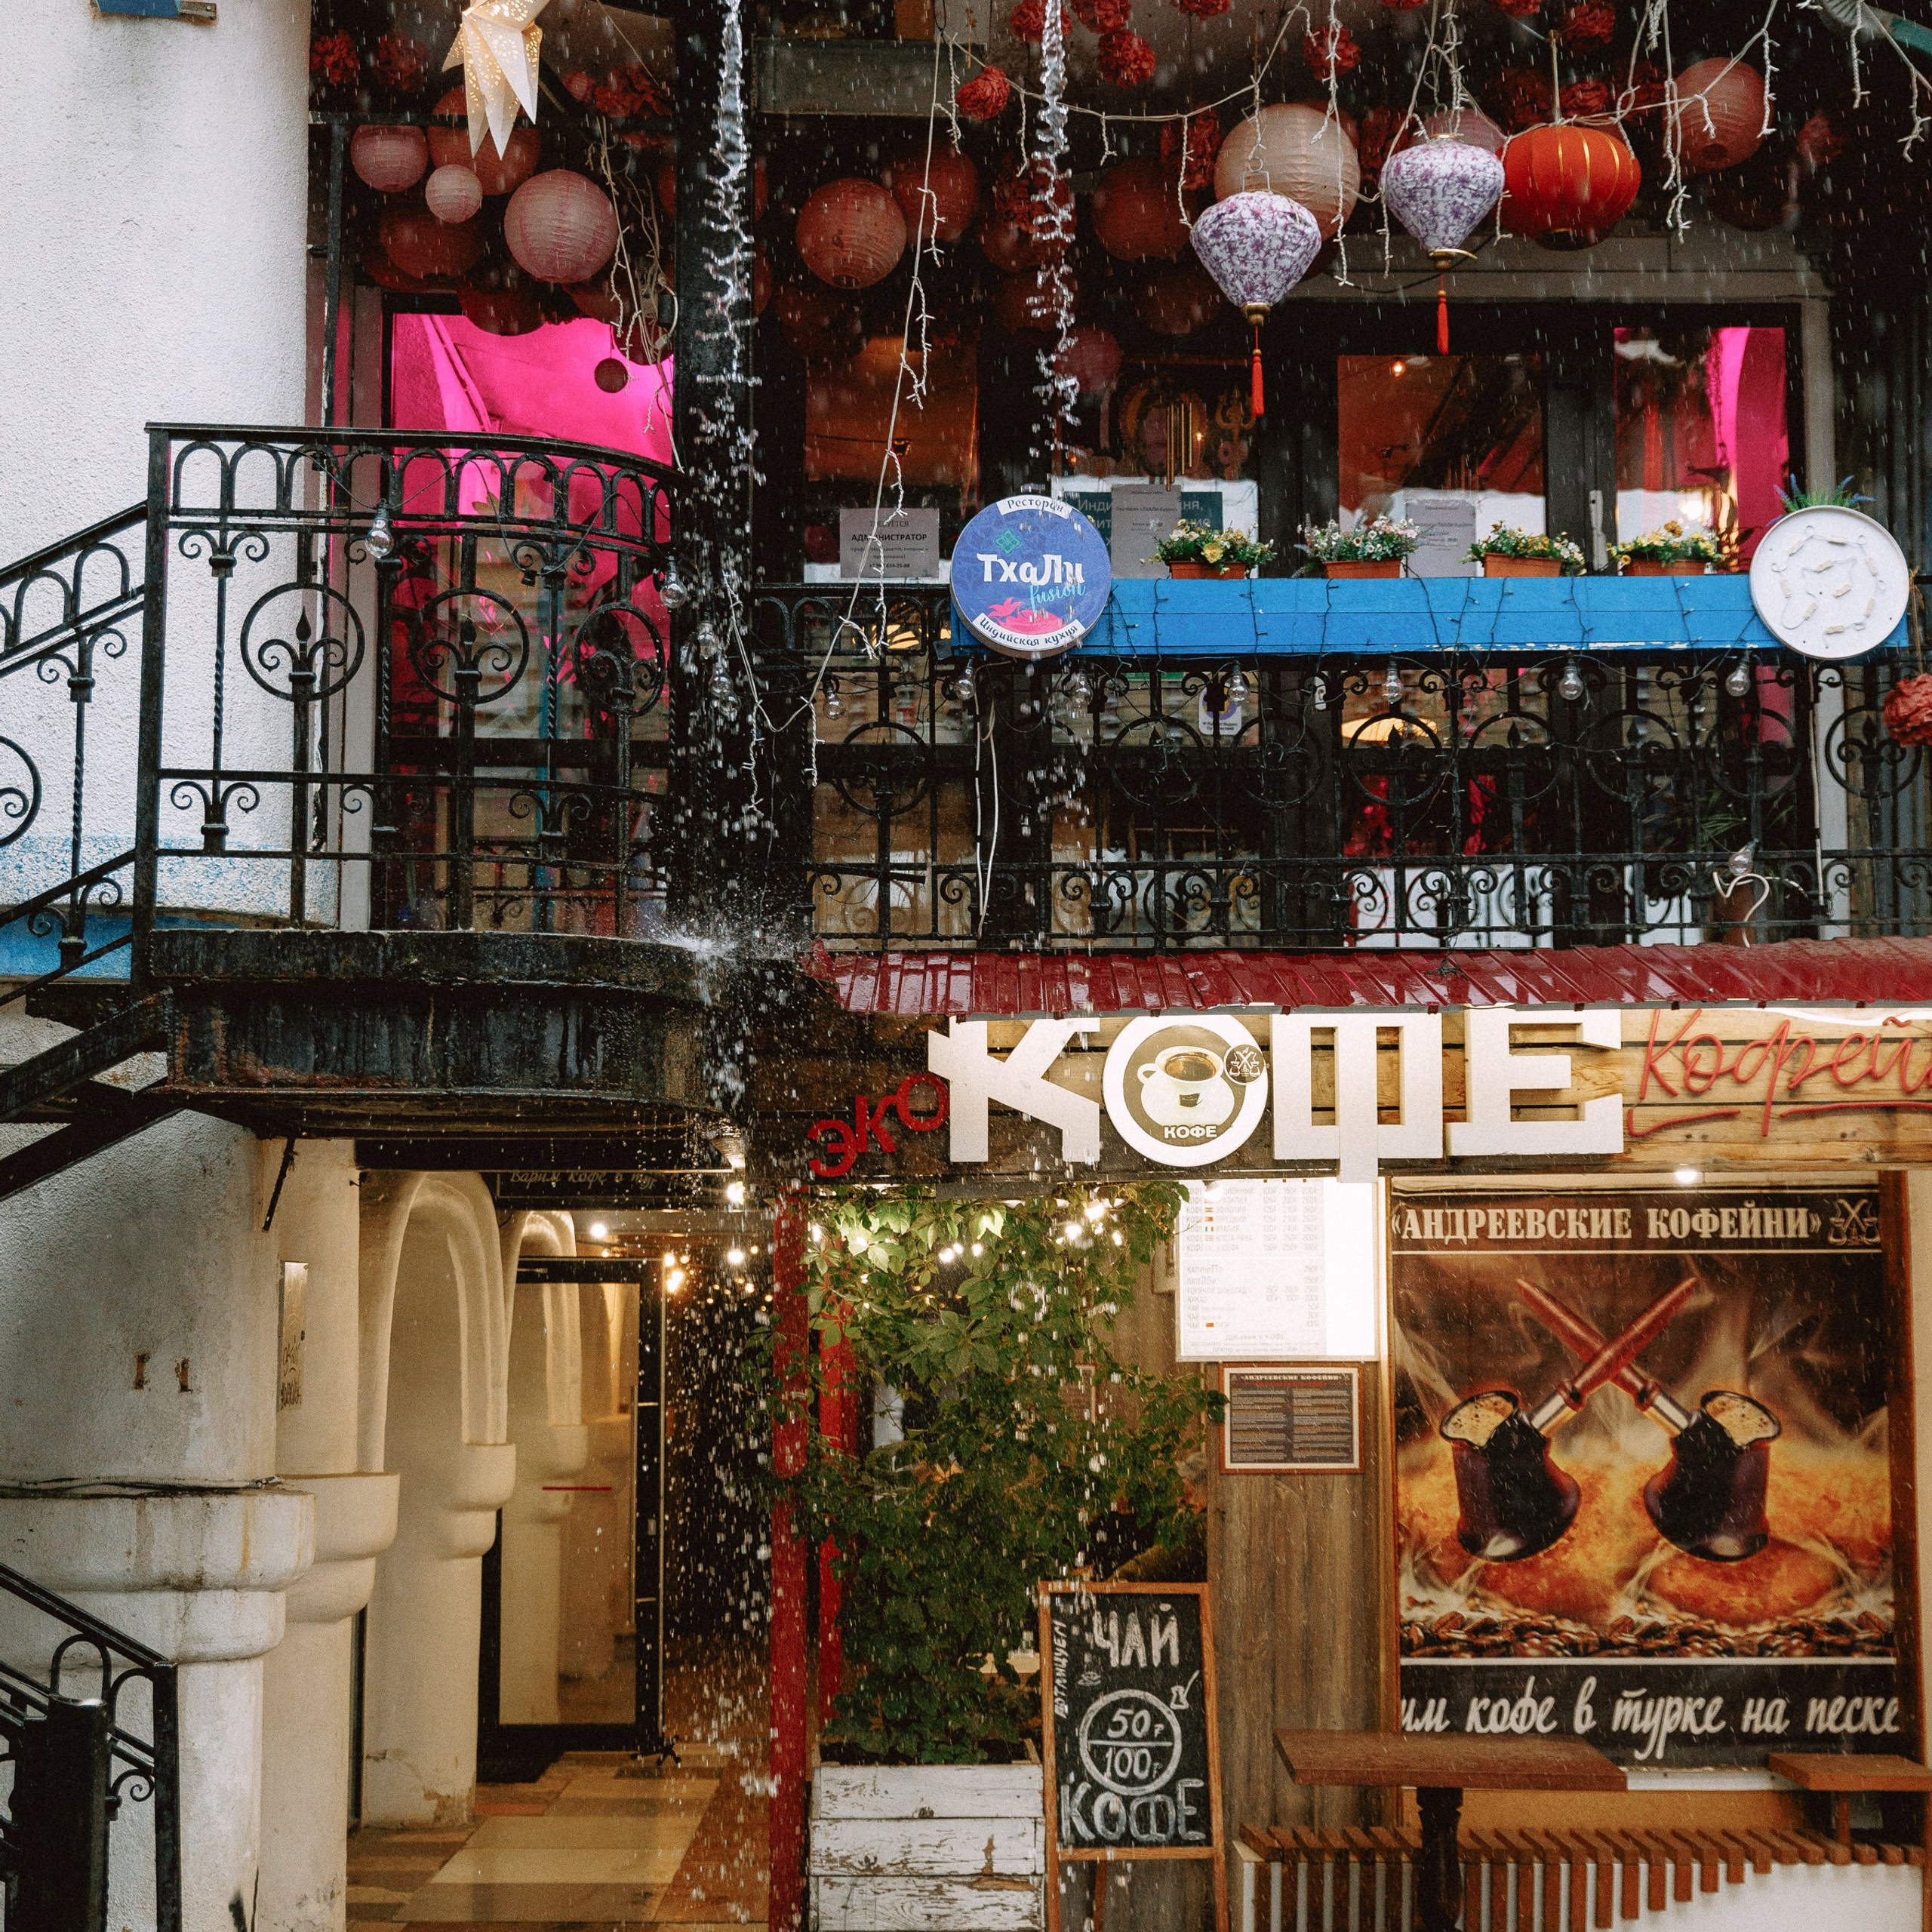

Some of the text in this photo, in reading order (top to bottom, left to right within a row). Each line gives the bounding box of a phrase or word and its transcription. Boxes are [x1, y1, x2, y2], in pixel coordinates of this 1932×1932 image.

[1007, 499, 1064, 513] Ресторан
[1029, 583, 1086, 614] fusion
[980, 617, 1078, 647] Индийская кухня
[1163, 1125, 1217, 1139] КОФЕ
[1391, 1200, 1822, 1245] «АНДРЕЕВСКИЕ КОФЕЙНИ»
[1092, 1603, 1180, 1668] ЧАЙ
[1466, 1675, 1558, 1734] кофе
[1573, 1675, 1598, 1735] в
[1611, 1687, 1727, 1761] турке
[1740, 1697, 1792, 1735] на
[1805, 1696, 1900, 1735] песке
[1060, 1778, 1207, 1842] КОФЕ
